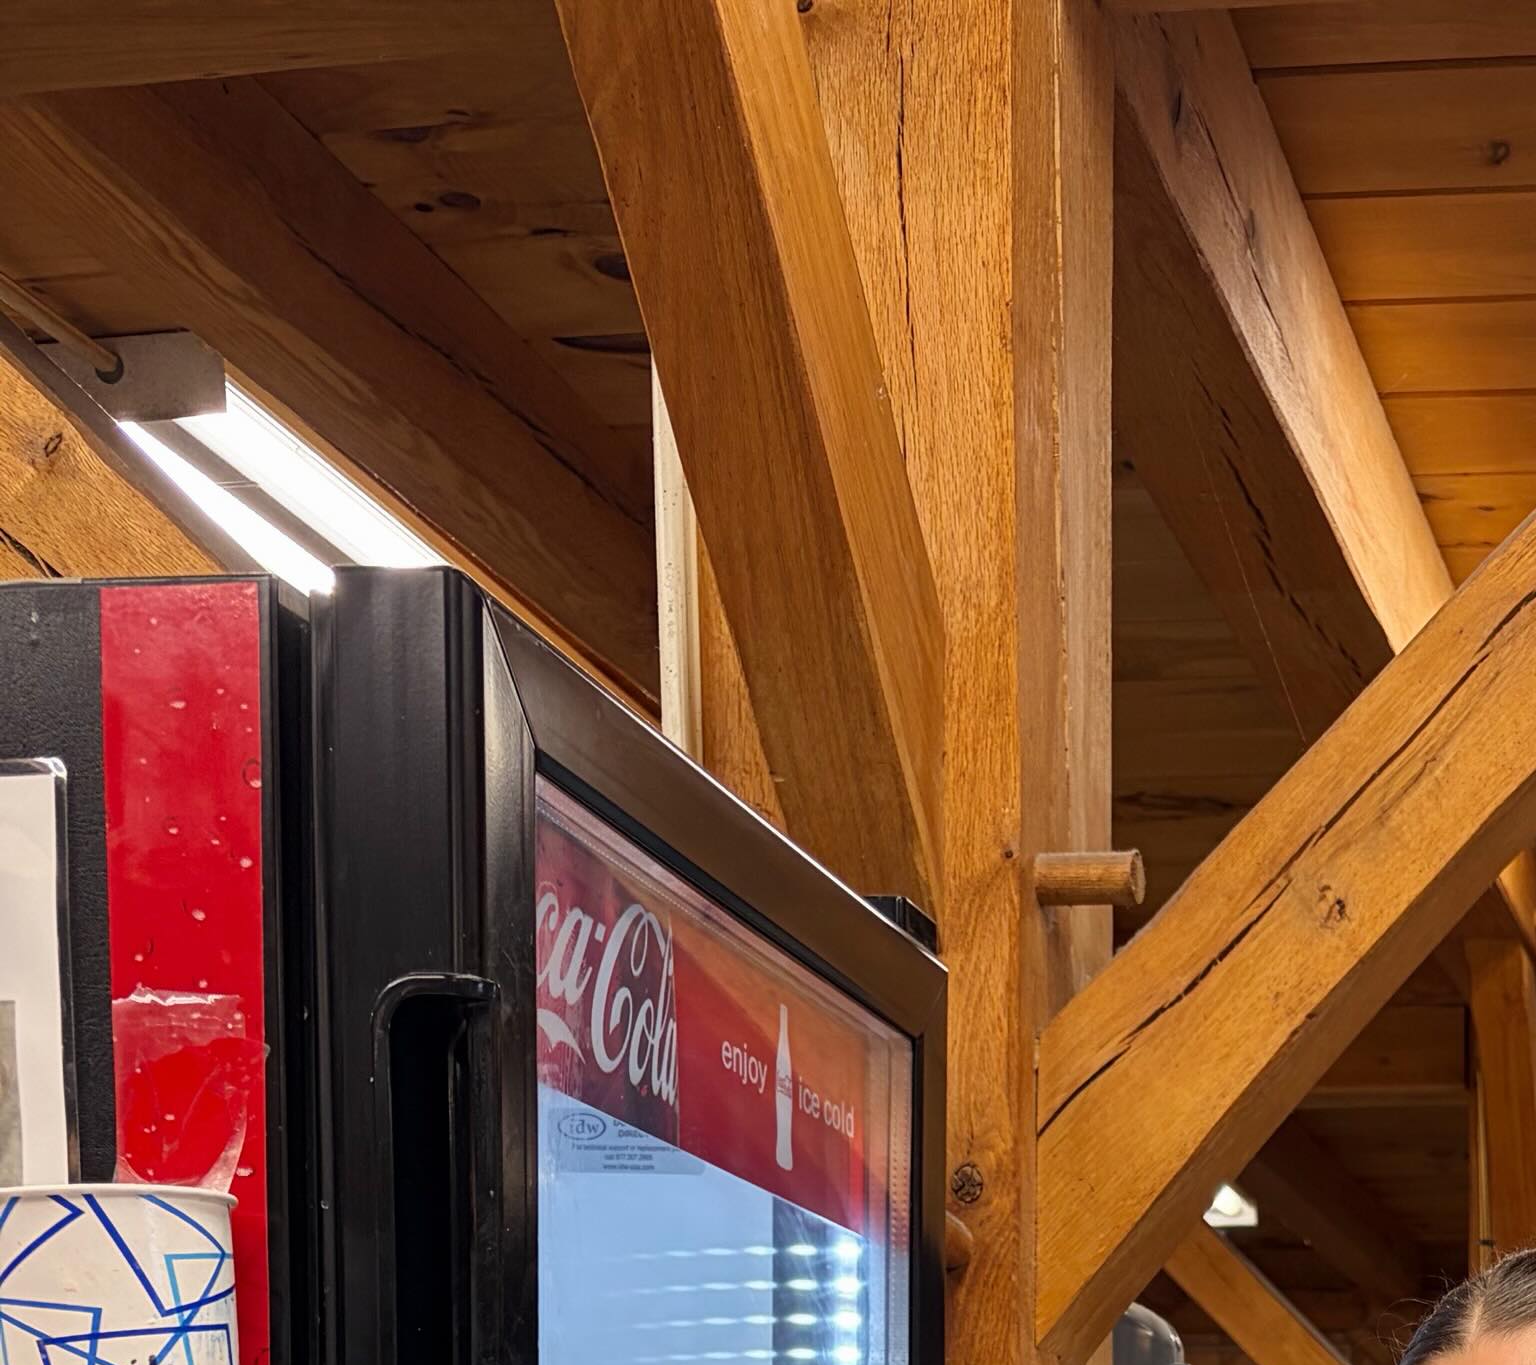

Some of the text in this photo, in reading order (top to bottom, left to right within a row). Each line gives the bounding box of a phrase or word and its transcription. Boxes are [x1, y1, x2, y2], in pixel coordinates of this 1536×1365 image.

[721, 1040, 855, 1139] enjoy ice cold
